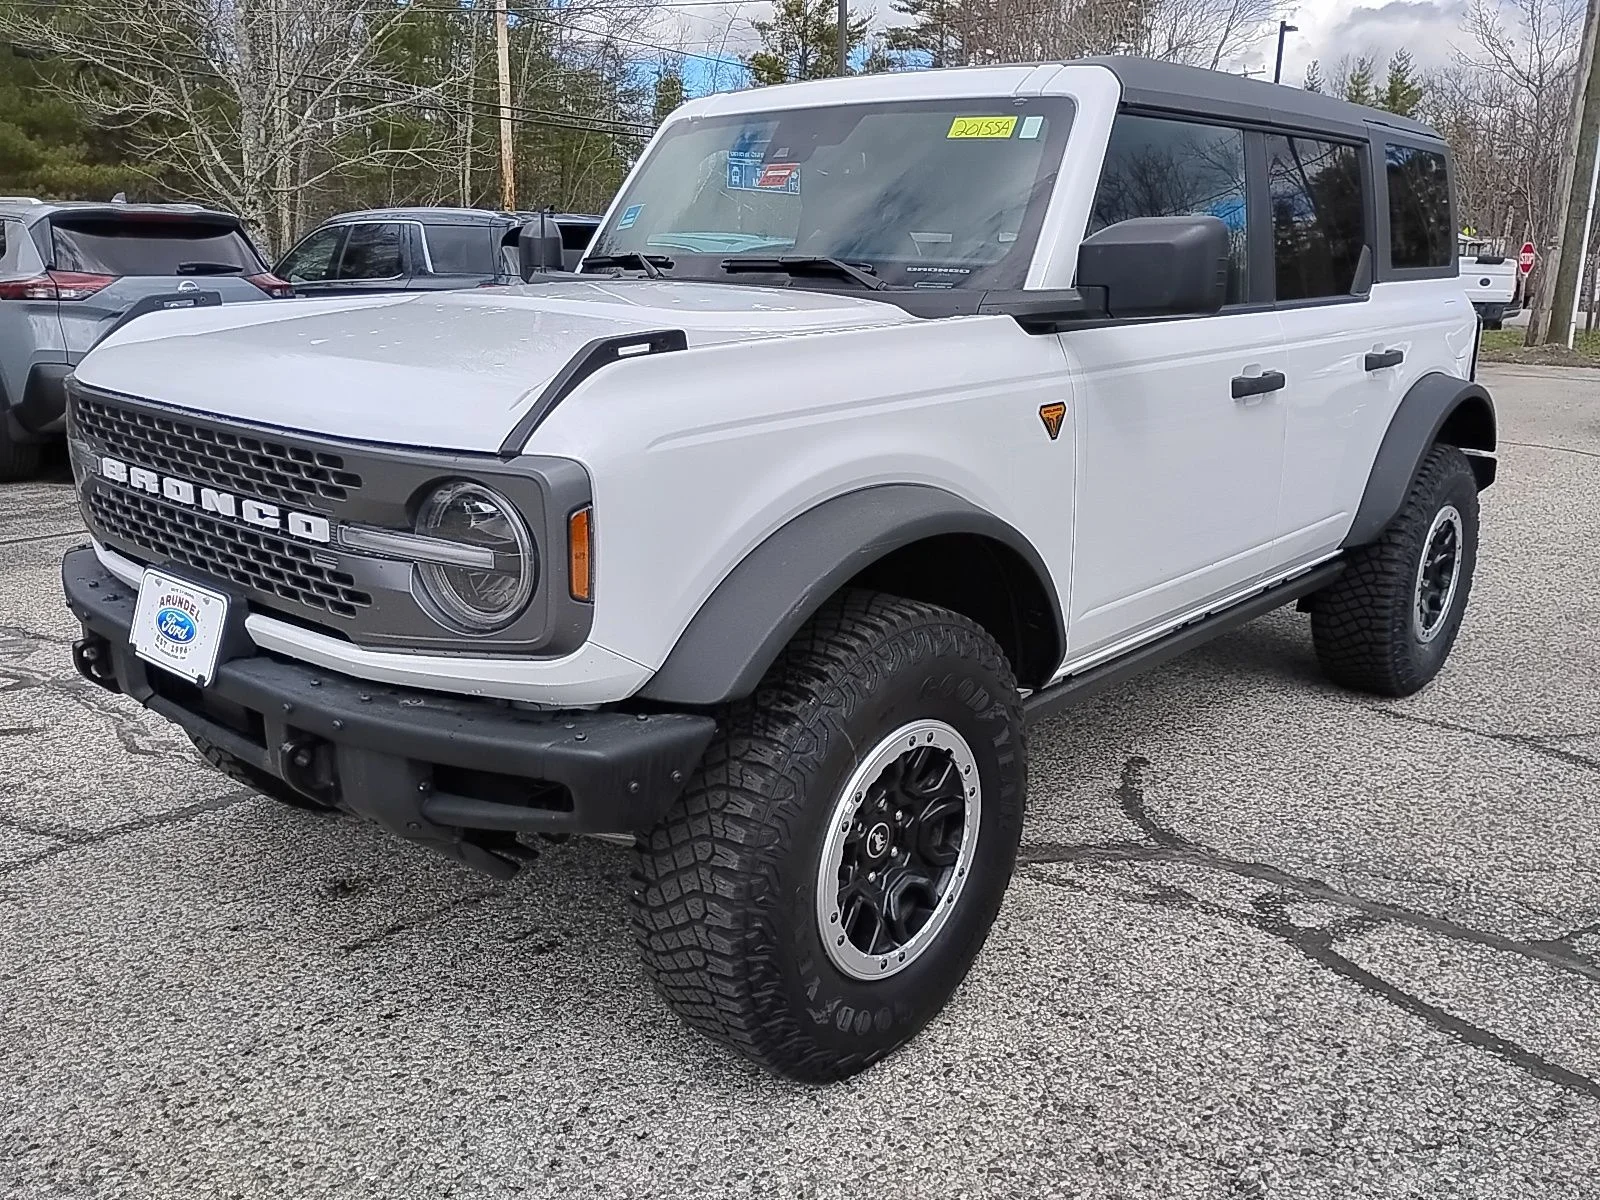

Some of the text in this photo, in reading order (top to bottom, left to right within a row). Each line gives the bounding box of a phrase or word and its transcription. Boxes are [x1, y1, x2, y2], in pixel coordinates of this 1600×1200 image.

[1520, 252, 1534, 265] STOP
[102, 456, 331, 544] BRONCO
[158, 594, 201, 623] ARUNDEL
[160, 611, 191, 641] Ford
